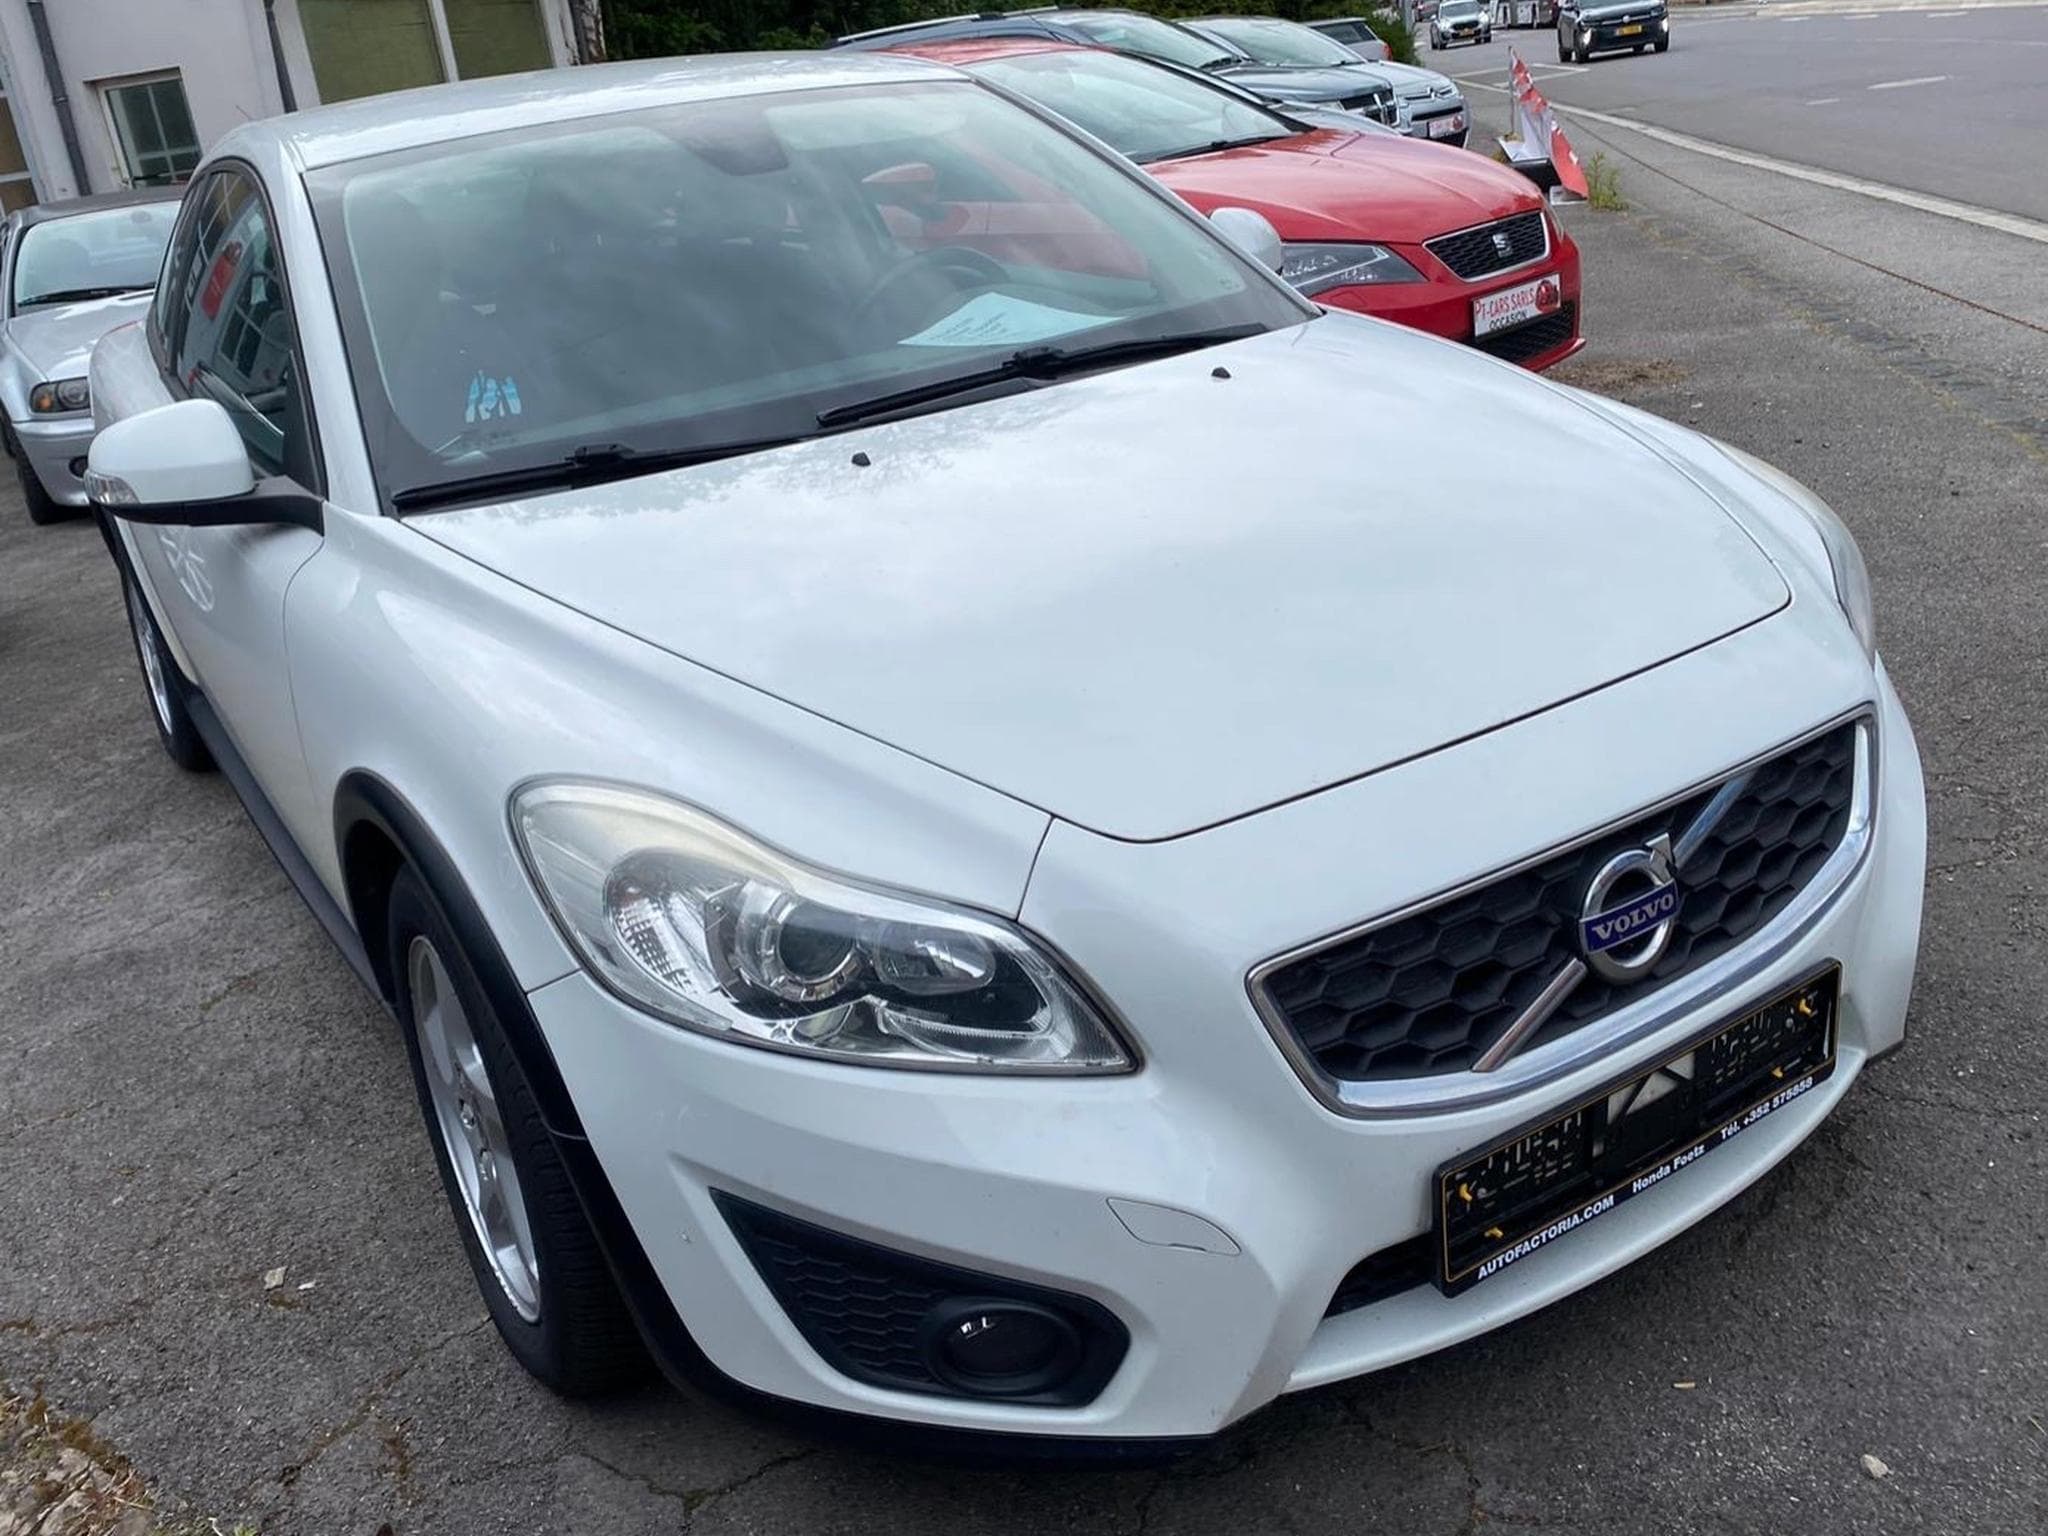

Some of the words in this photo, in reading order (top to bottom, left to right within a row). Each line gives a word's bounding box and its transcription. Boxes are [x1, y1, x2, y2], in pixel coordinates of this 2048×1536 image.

[1592, 893, 1674, 940] VOLVO
[1478, 1195, 1615, 1280] AUTOFACTORIA.COM
[1632, 1165, 1671, 1193] Honda
[1674, 1144, 1705, 1170] Foetz
[1743, 1102, 1770, 1125] +352
